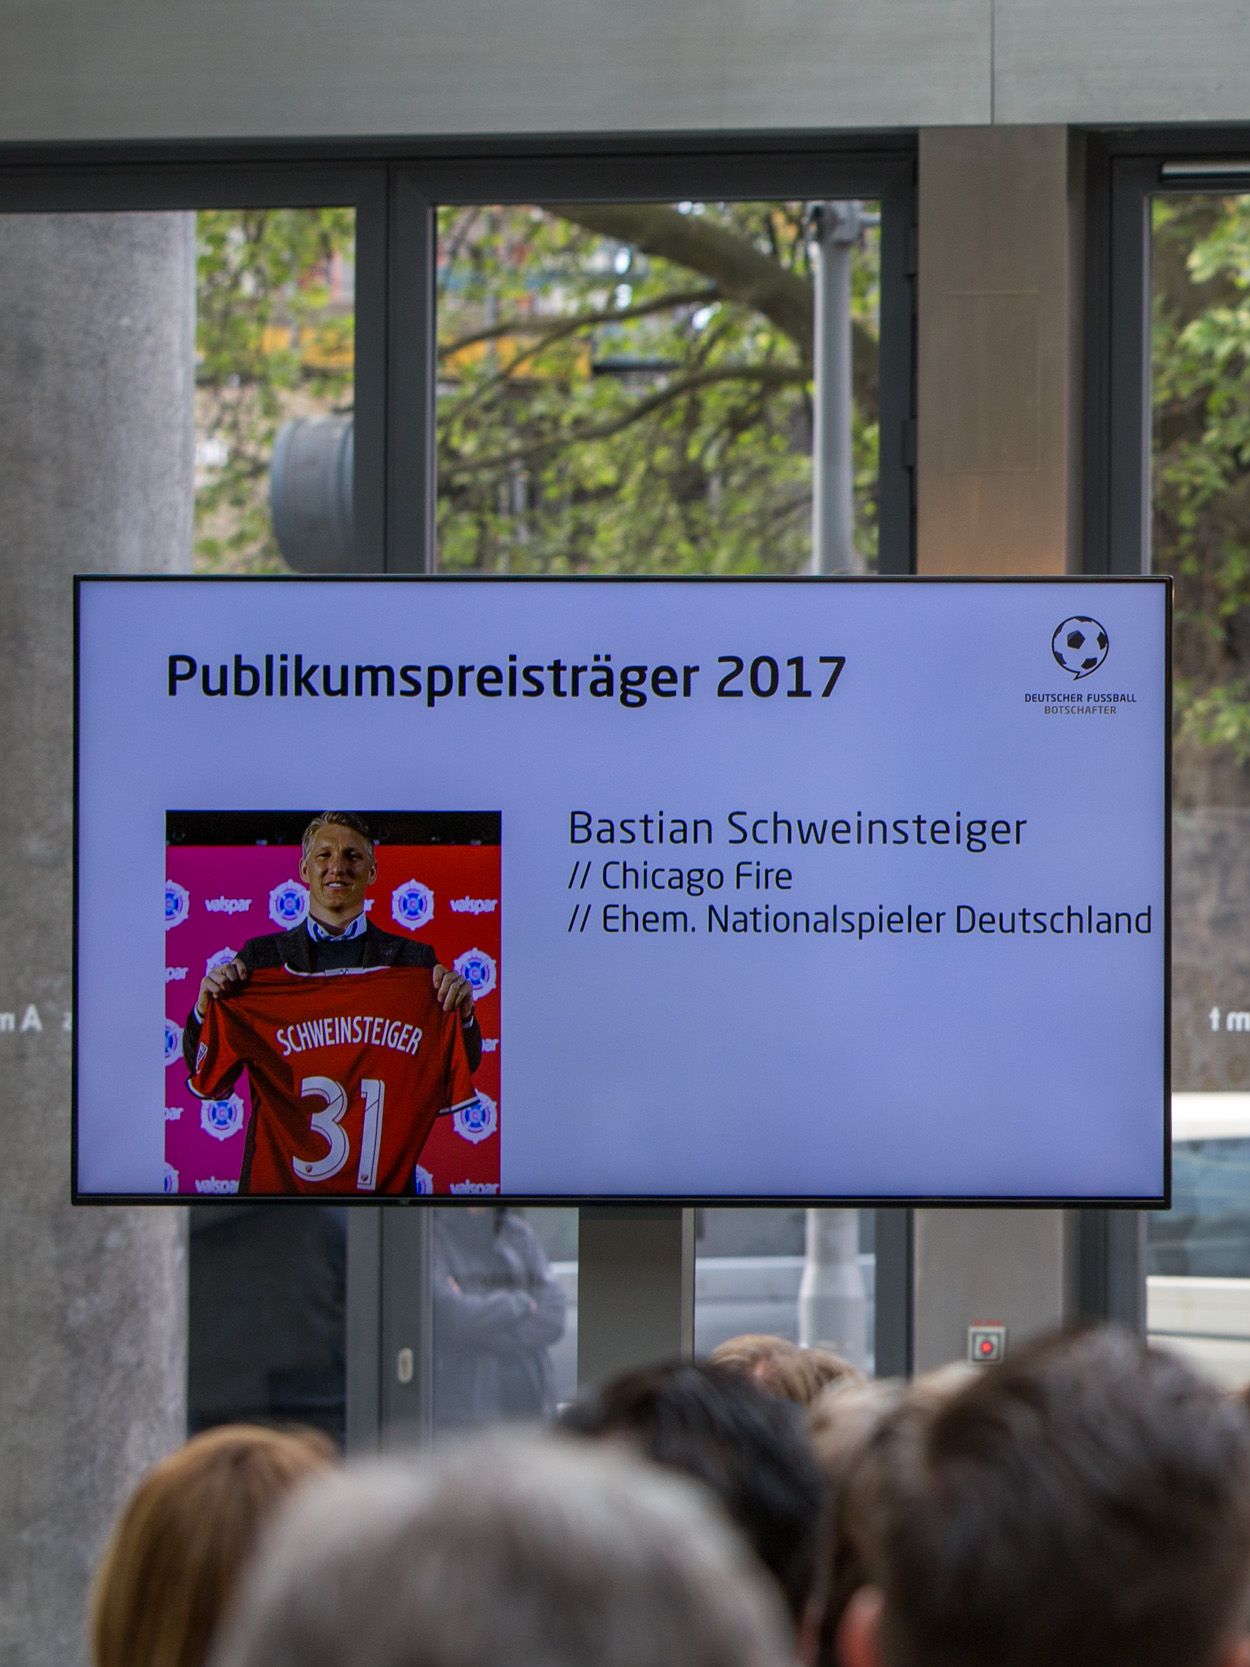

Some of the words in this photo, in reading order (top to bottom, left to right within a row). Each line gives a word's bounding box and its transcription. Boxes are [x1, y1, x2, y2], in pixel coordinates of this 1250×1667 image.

[168, 653, 700, 709] Publikumspreisträger
[717, 655, 846, 698] 2017
[1024, 693, 1083, 703] DEUTSCHER
[1087, 693, 1137, 703] FUSSBALL
[1044, 705, 1117, 715] BOTSCHAFTER
[570, 810, 713, 845] Bastian
[727, 810, 1028, 853] Schweinsteiger
[602, 860, 725, 897] Chicago
[735, 860, 793, 890] Fire
[602, 903, 696, 933] Ehem.
[708, 903, 947, 941] Nationalspieler
[956, 904, 1152, 934] Deutschland
[276, 1016, 423, 1056] SCHWEINSTEIGER
[293, 1076, 385, 1191] 31
